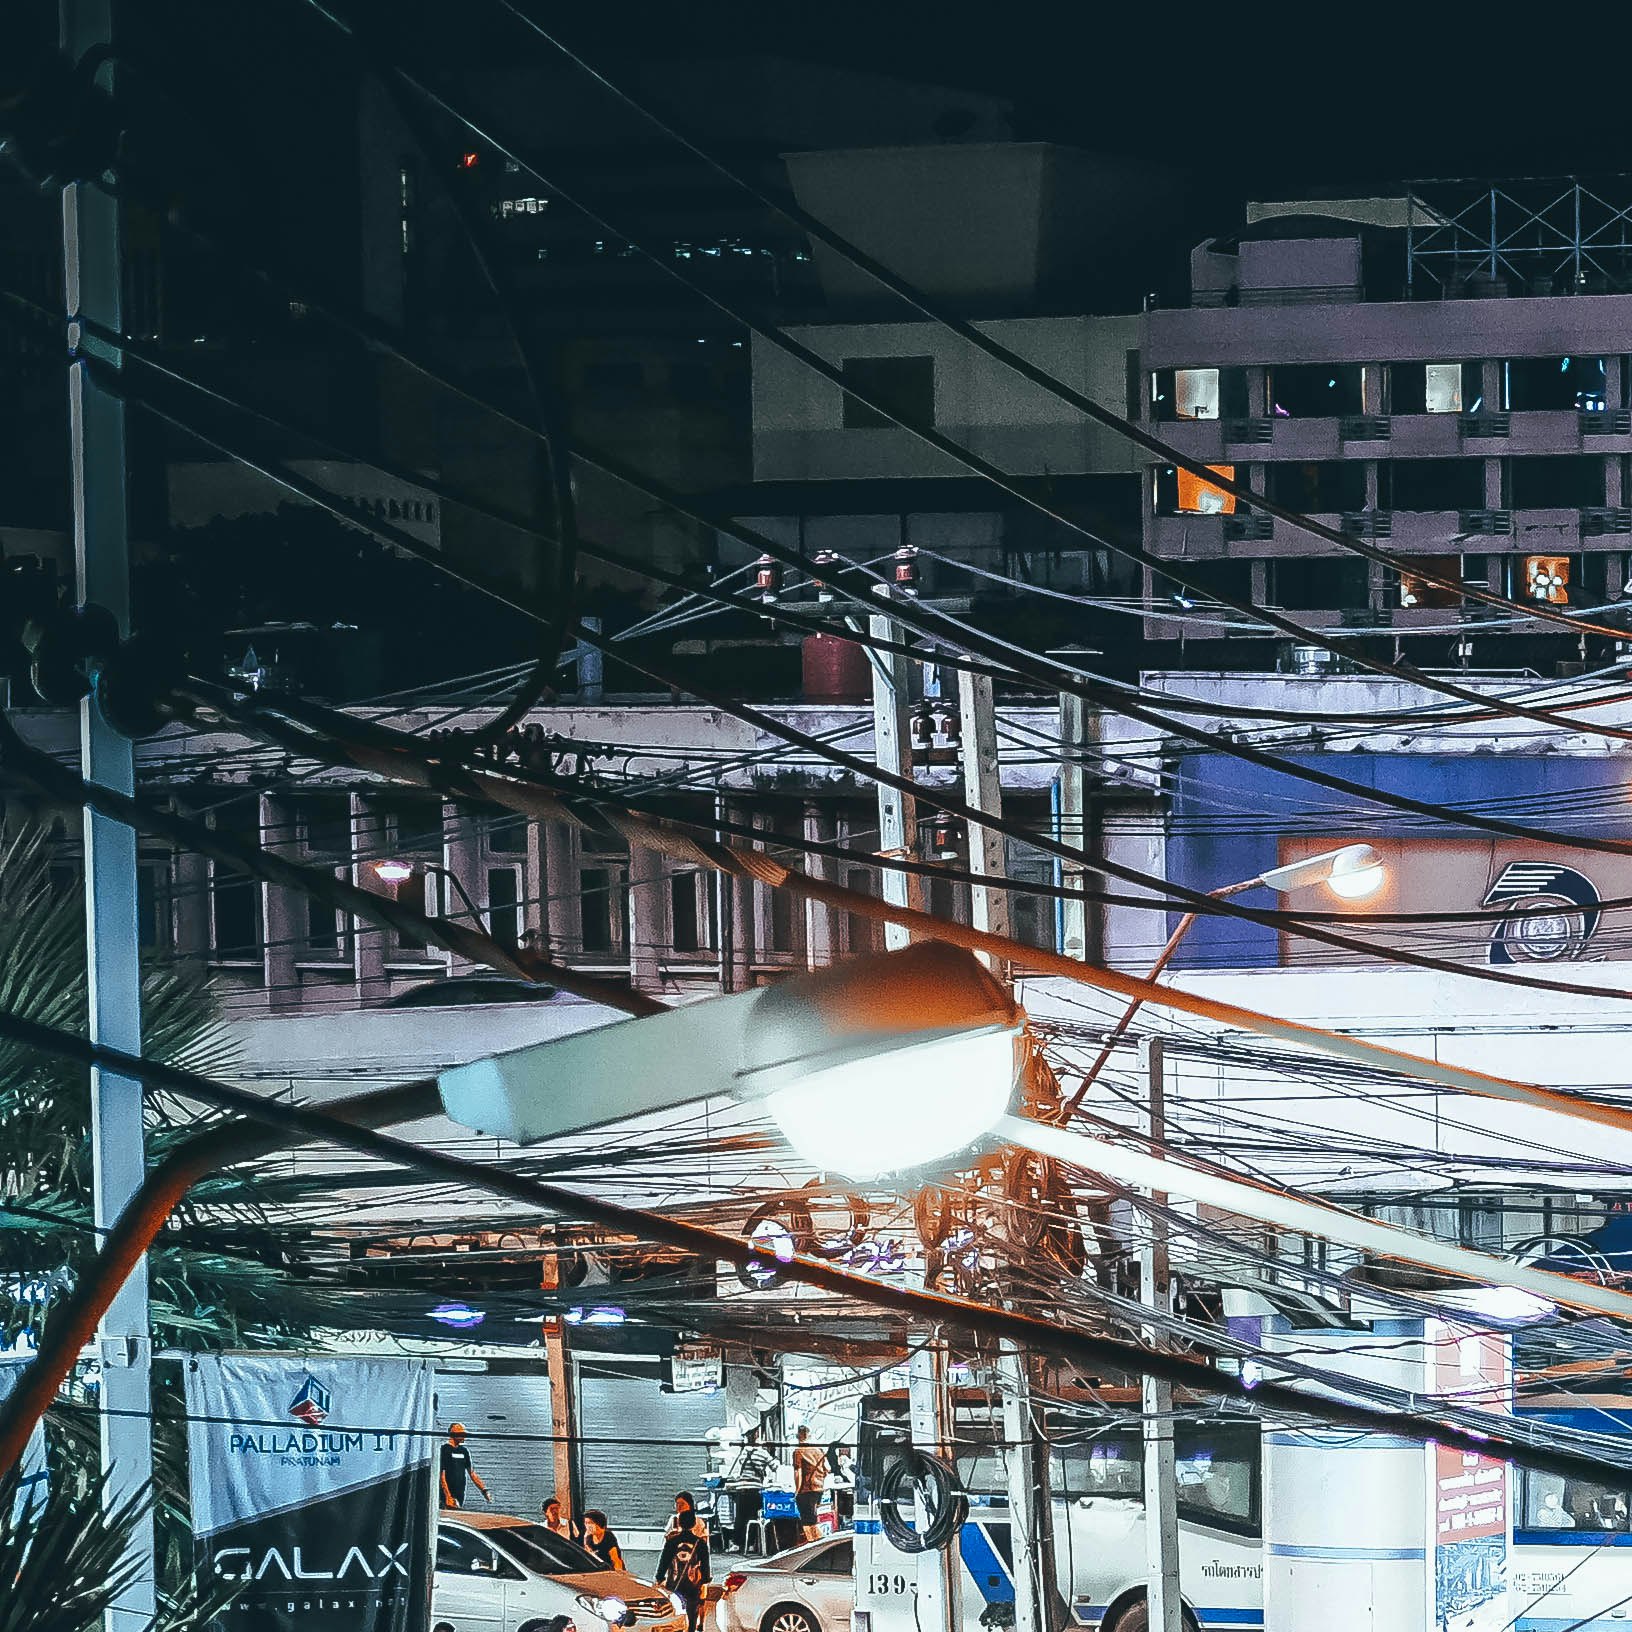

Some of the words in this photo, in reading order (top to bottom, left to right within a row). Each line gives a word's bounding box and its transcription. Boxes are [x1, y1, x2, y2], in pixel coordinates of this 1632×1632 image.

[230, 1433, 363, 1454] PALLADIUM
[373, 1433, 395, 1452] IT
[213, 1542, 409, 1580] GALAX
